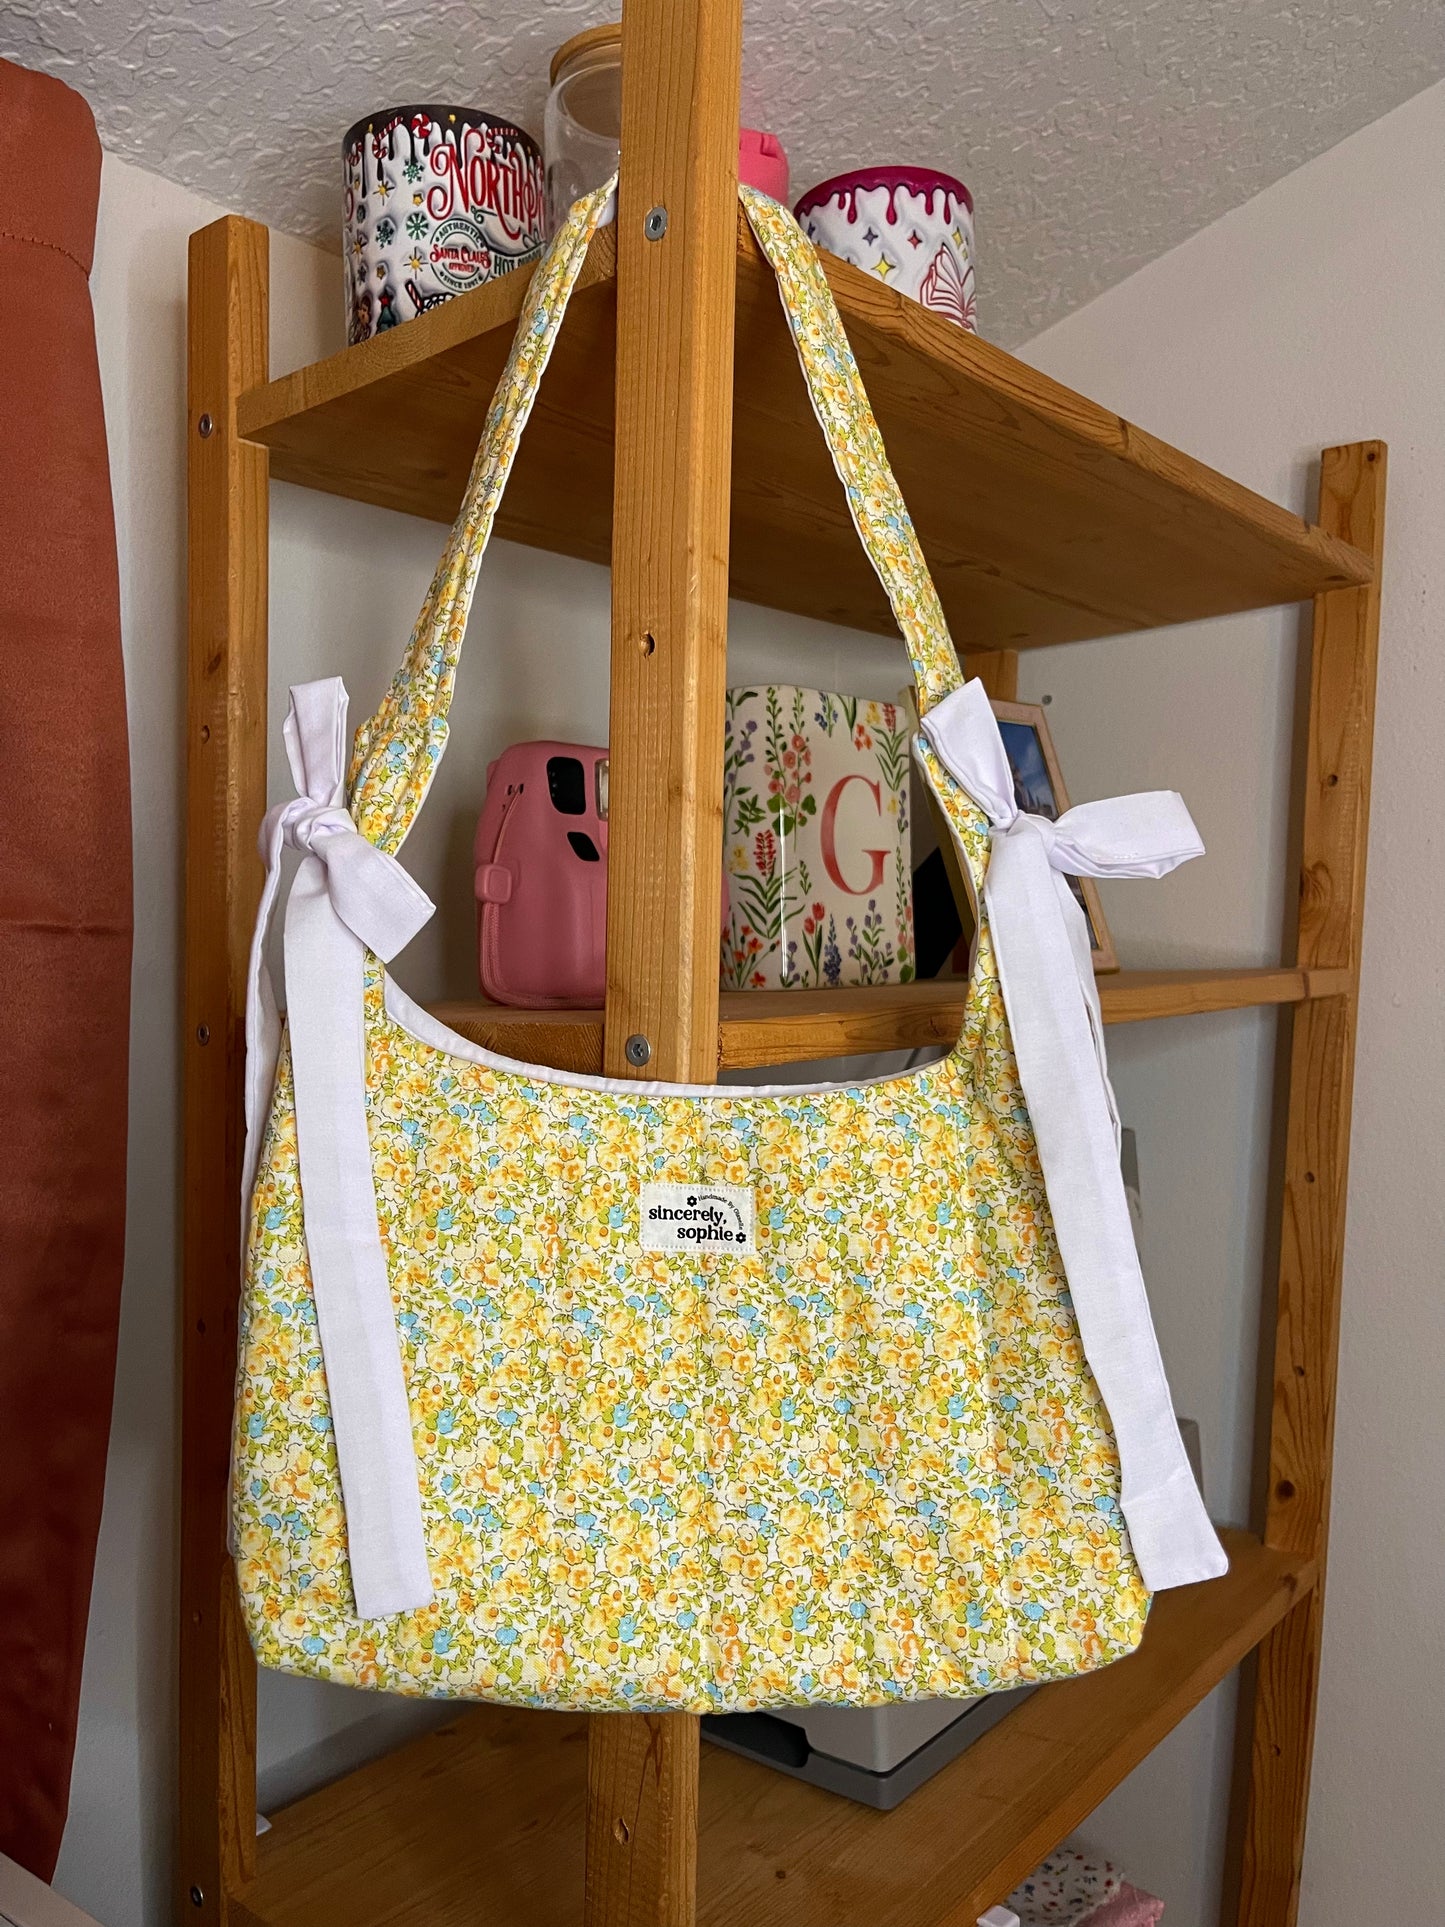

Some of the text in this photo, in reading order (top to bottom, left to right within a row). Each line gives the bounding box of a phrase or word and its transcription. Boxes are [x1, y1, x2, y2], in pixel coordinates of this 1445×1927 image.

[427, 128, 525, 241] NORTH
[438, 221, 482, 244] AUTHENTIC
[429, 243, 460, 263] SANTA
[442, 275, 463, 289] SINCE
[820, 774, 891, 896] G
[648, 1204, 727, 1226] sincerely,
[676, 1224, 734, 1244] sophie
